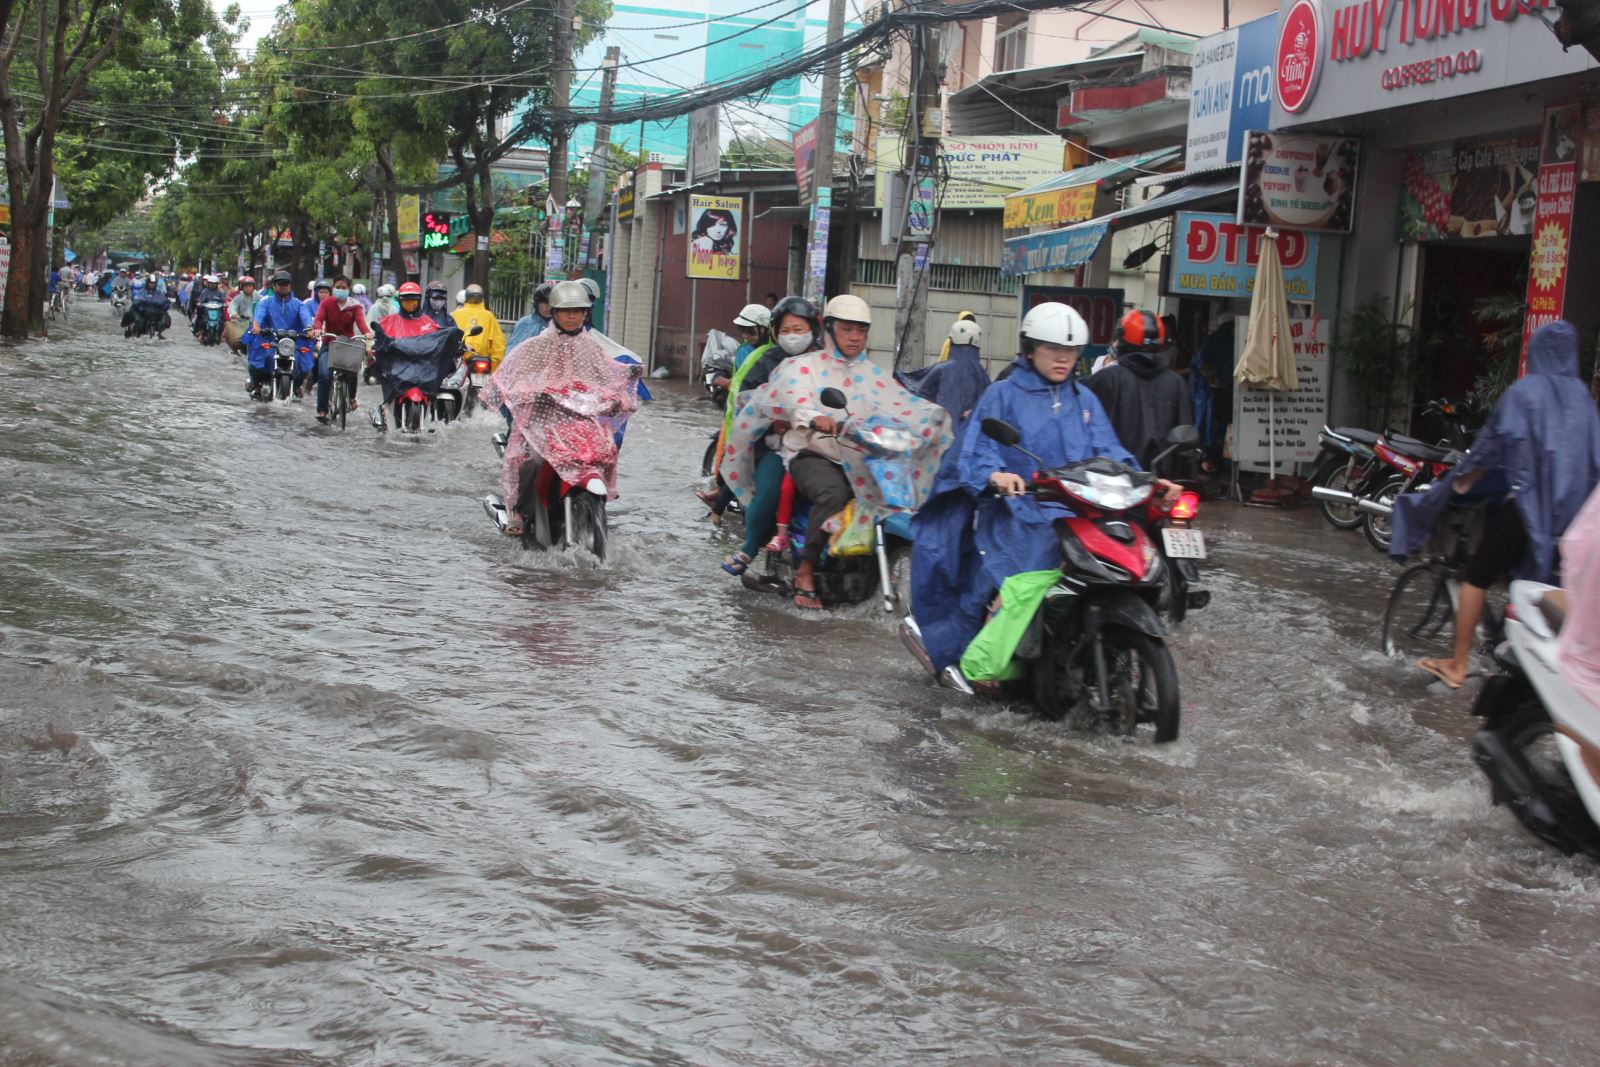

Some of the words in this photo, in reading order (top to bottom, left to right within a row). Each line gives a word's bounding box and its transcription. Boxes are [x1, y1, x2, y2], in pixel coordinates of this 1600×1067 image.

[1331, 0, 1391, 61] HUY
[1381, 58, 1435, 91] COFFEE
[1435, 54, 1455, 80] TO
[1455, 49, 1482, 74] GO
[1213, 80, 1231, 114] ANH
[693, 199, 712, 207] Hair
[715, 200, 740, 209] Salon
[1181, 273, 1206, 288] MUA
[1210, 272, 1235, 290] BÁN
[1526, 314, 1554, 334] 10000
